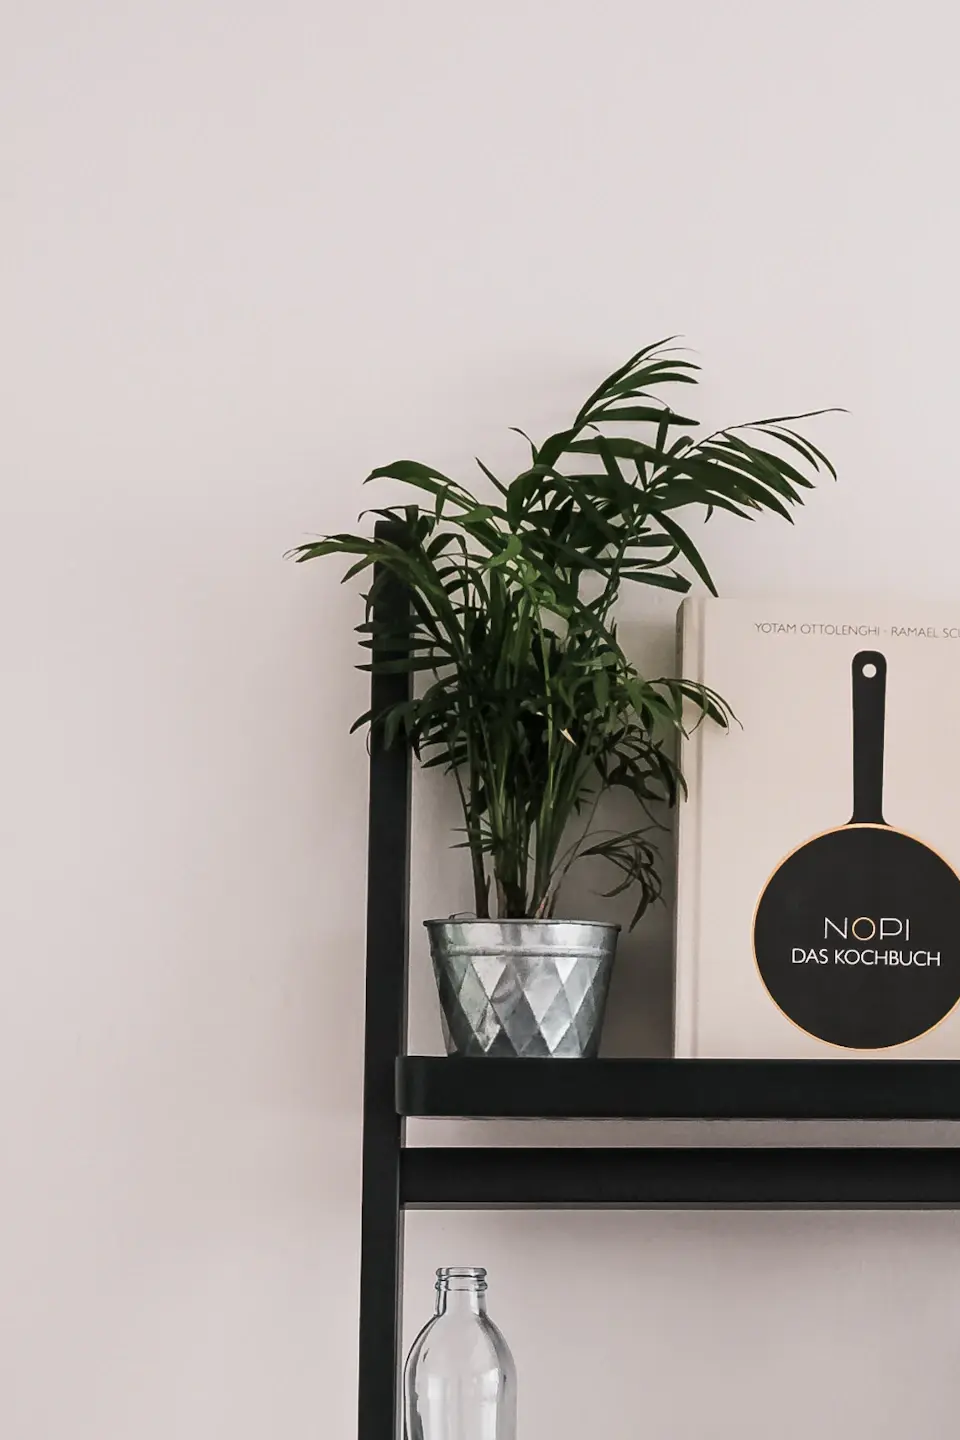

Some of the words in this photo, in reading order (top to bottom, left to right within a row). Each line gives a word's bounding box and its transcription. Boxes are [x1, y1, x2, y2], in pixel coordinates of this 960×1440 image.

[754, 622, 797, 635] YOTAM
[800, 623, 880, 637] OTTOLENGHI
[891, 626, 939, 638] RAMAEL
[824, 916, 910, 941] NOPI
[791, 948, 829, 964] DAS
[834, 949, 941, 967] KOCHBUCH
